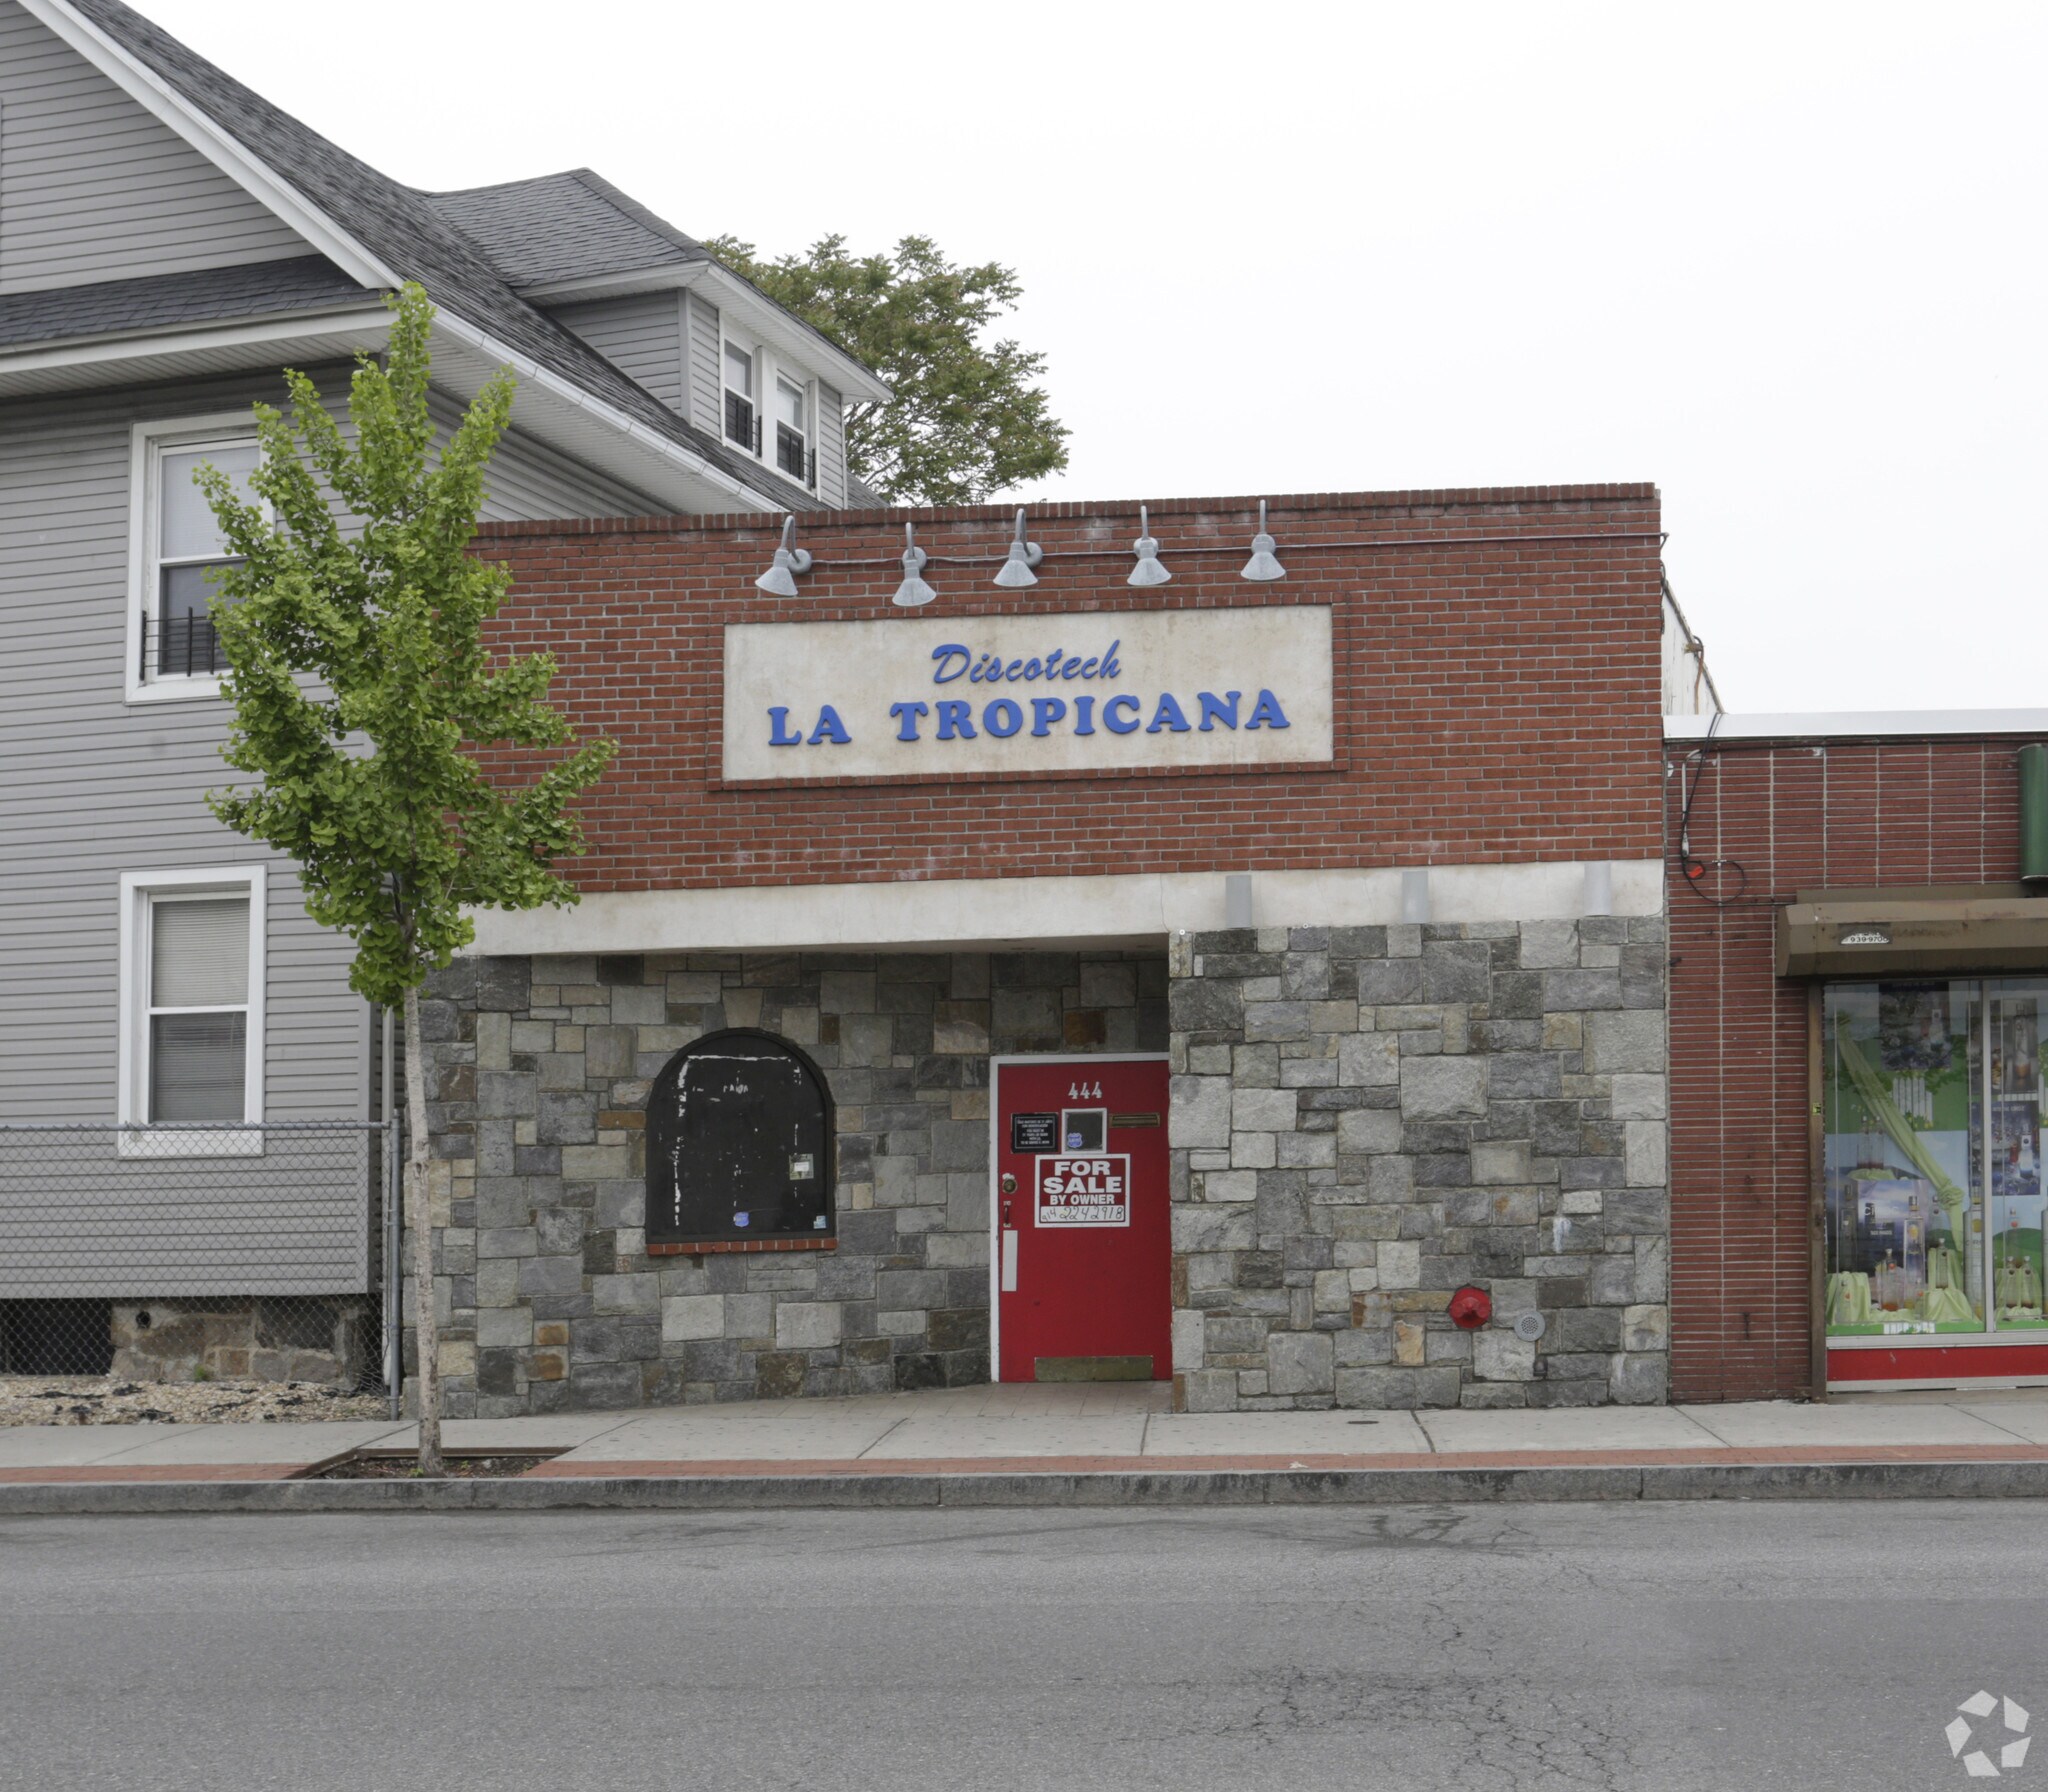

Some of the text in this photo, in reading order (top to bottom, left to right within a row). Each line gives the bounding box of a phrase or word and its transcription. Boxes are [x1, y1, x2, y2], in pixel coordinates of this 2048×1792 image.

[932, 640, 1121, 683] Discotech
[768, 689, 1289, 746] LA TROPICANA
[1068, 1081, 1102, 1099] 444
[1054, 1160, 1111, 1176] FOR
[1043, 1176, 1122, 1194] SALE
[1050, 1194, 1115, 1205] BY OWNER
